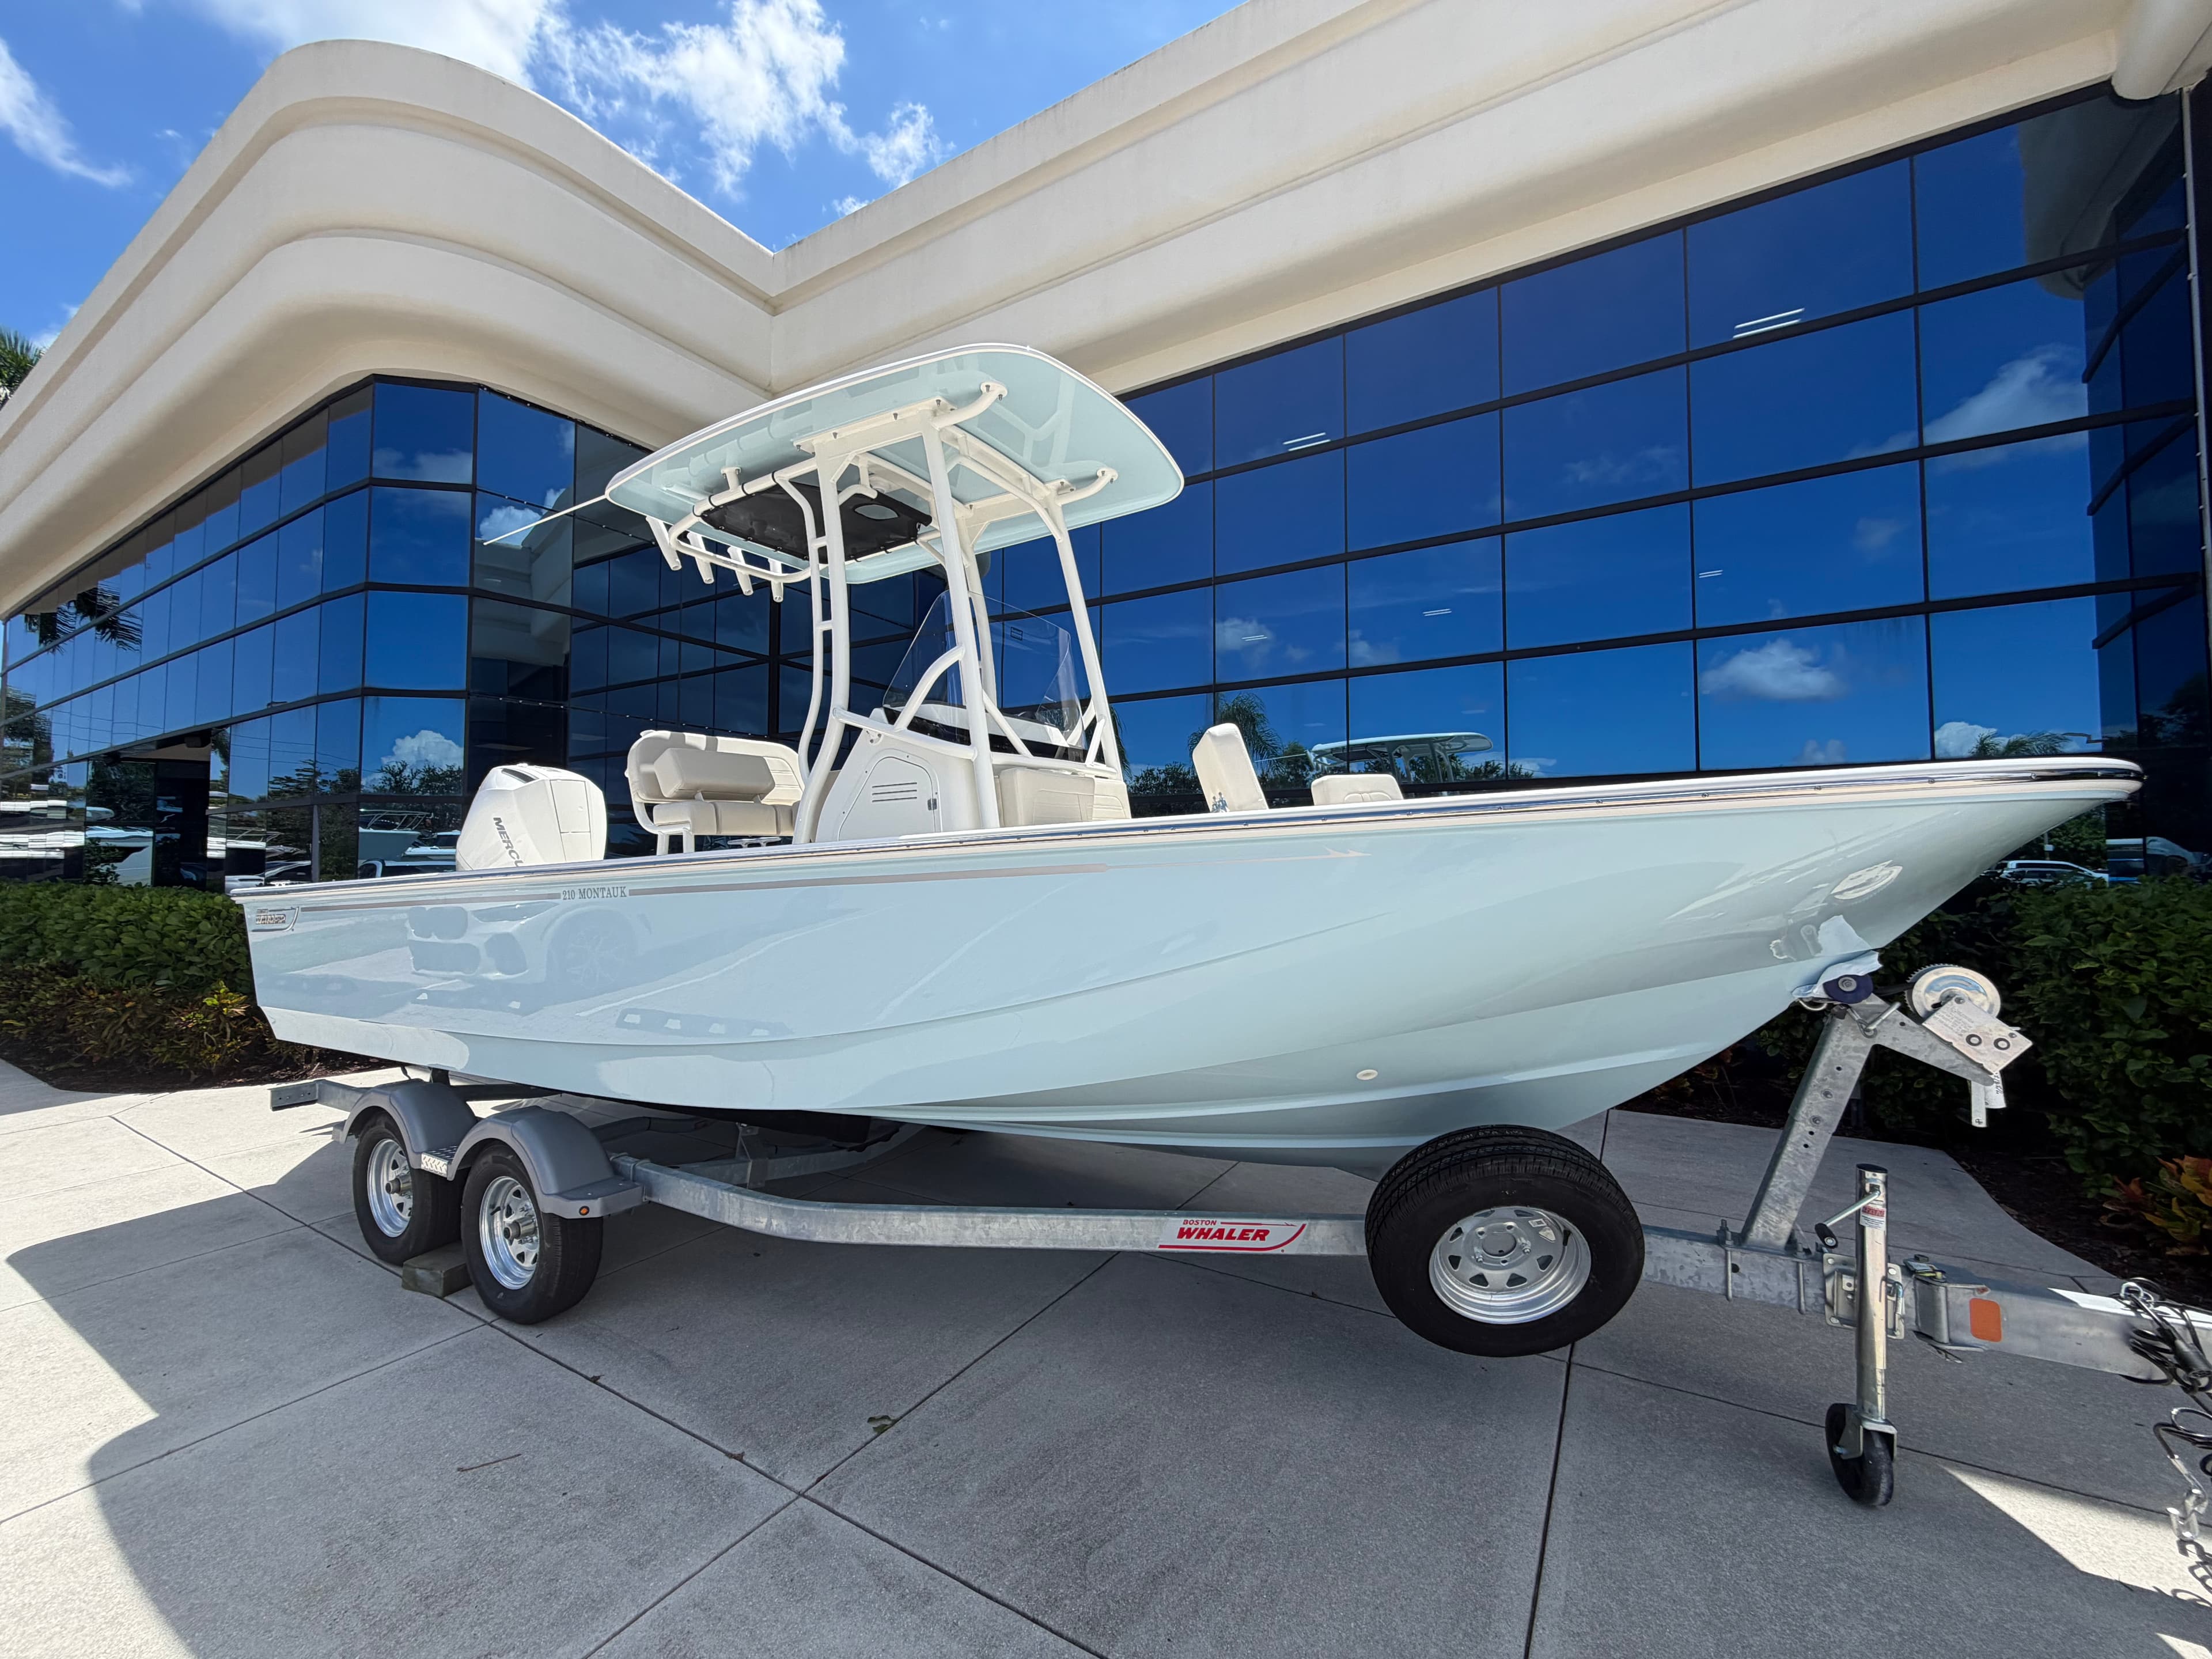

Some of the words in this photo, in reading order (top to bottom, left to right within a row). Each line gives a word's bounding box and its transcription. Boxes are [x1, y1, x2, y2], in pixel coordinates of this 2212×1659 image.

[562, 889, 575, 900] 210
[578, 886, 627, 899] MONTAUK
[1176, 1226, 1270, 1241] WHALER
